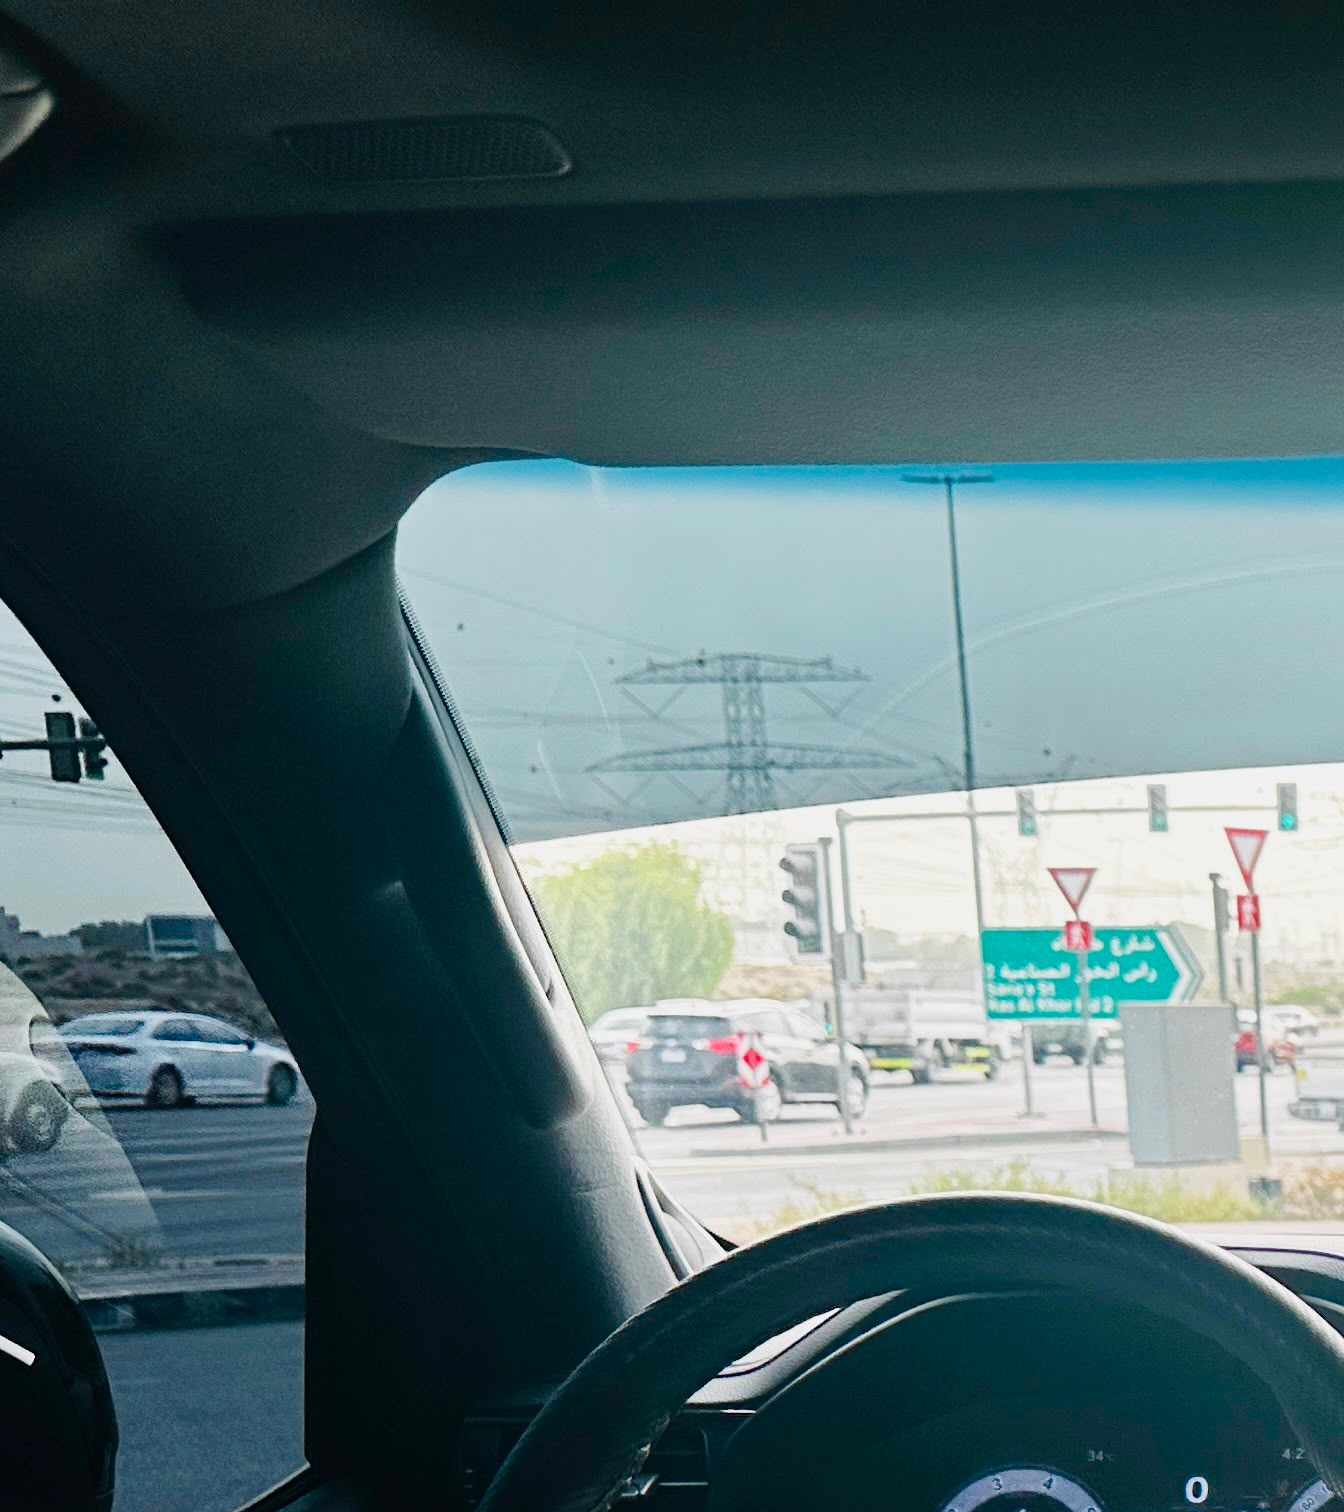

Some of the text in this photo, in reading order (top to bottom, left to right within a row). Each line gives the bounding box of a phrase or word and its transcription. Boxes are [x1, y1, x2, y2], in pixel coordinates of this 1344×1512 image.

[991, 1477, 1003, 1490] 3
[1042, 1477, 1054, 1490] 4
[1185, 1475, 1210, 1504] 0
